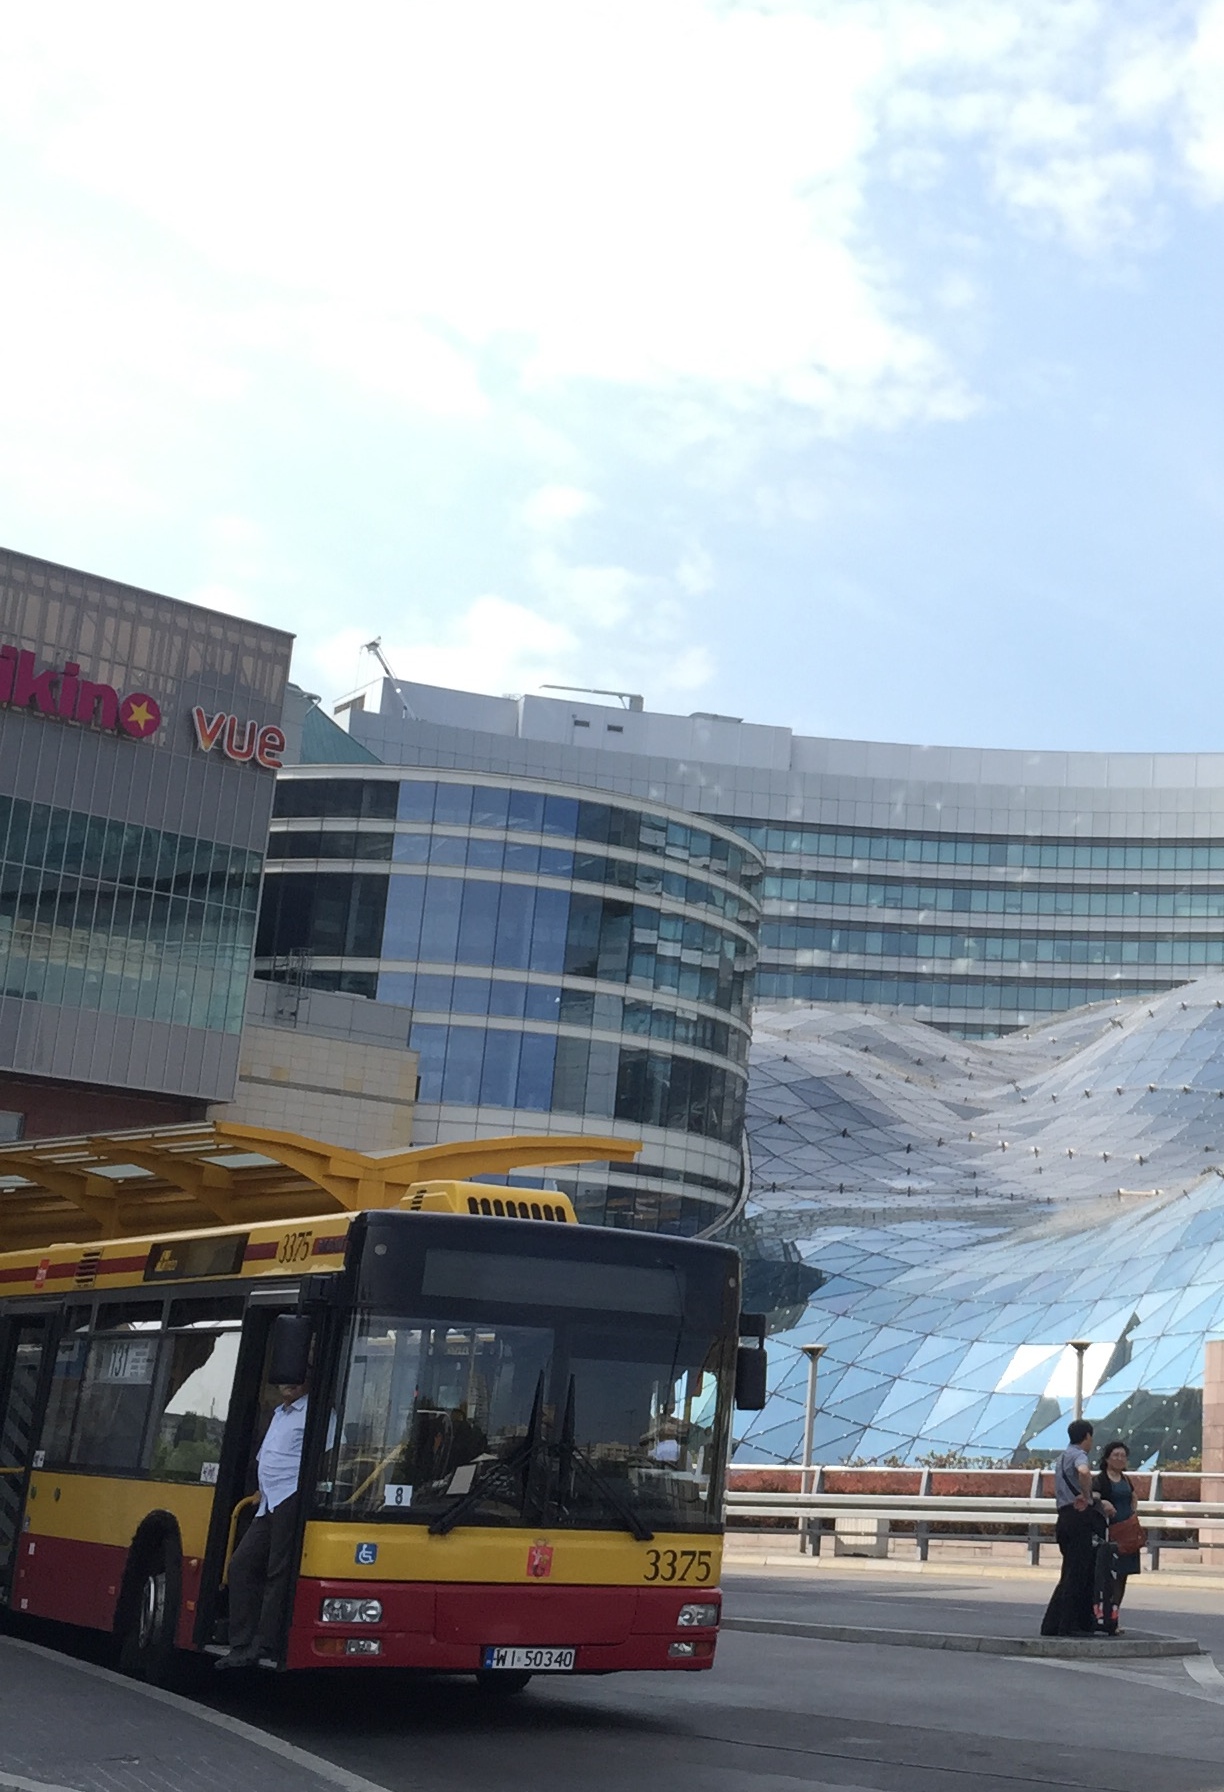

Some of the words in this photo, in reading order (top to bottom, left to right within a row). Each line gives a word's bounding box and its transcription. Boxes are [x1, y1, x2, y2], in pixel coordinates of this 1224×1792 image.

[191, 705, 287, 769] vue
[278, 1231, 313, 1264] 3375
[395, 1487, 404, 1505] 8
[643, 1549, 711, 1582] 3375
[524, 1650, 574, 1668] 50340
